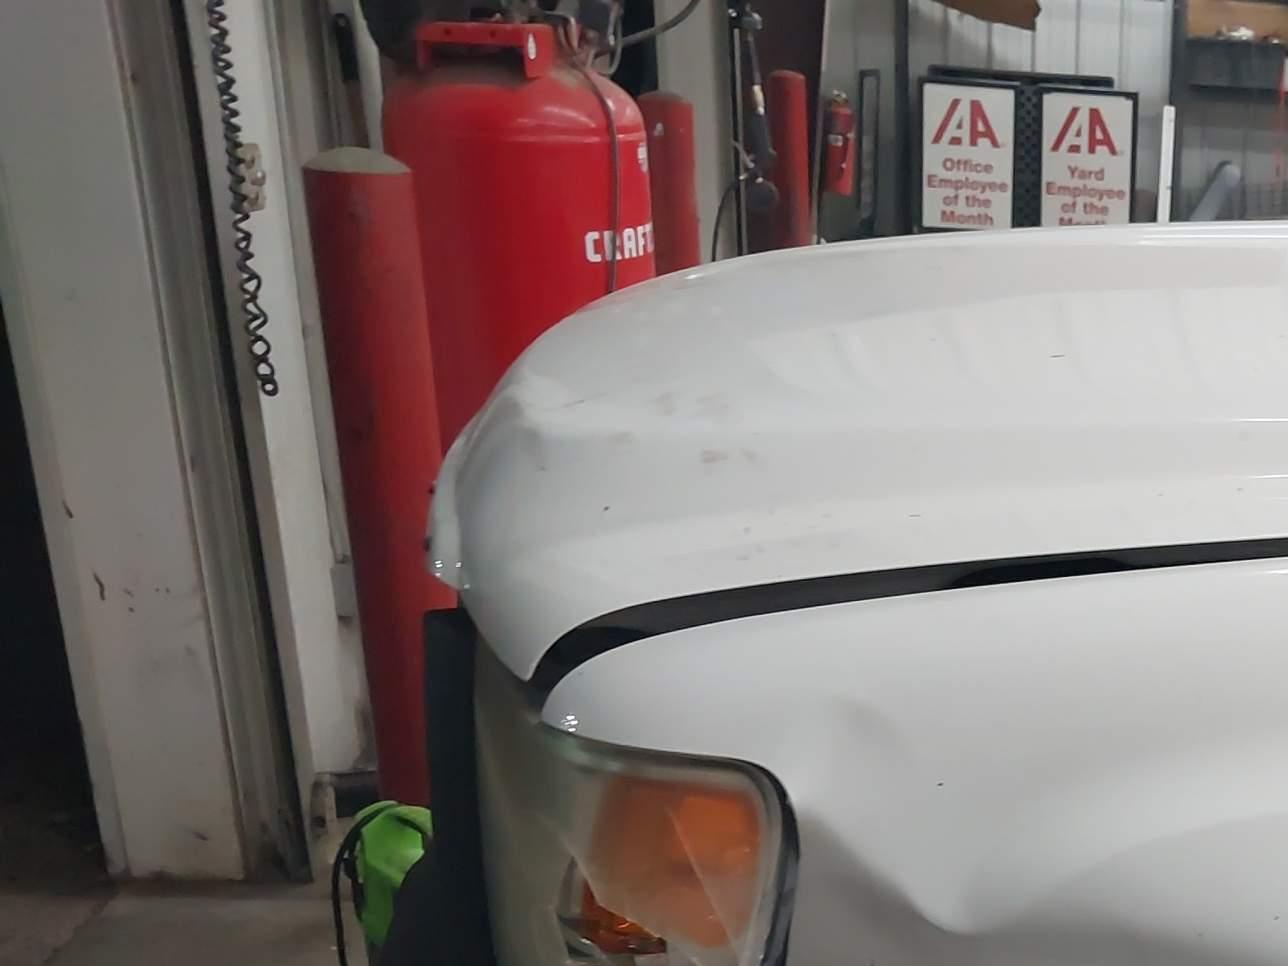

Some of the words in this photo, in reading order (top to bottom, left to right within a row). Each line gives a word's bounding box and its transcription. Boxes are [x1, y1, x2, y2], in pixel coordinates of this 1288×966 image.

[942, 158, 994, 173] Office
[1067, 165, 1105, 181] Yard
[927, 174, 1009, 193] Employee
[1046, 182, 1126, 201] Employee
[942, 194, 959, 206] of
[965, 195, 992, 208] the
[1061, 201, 1077, 213] of
[1083, 202, 1109, 216] the
[941, 210, 994, 225] Month
